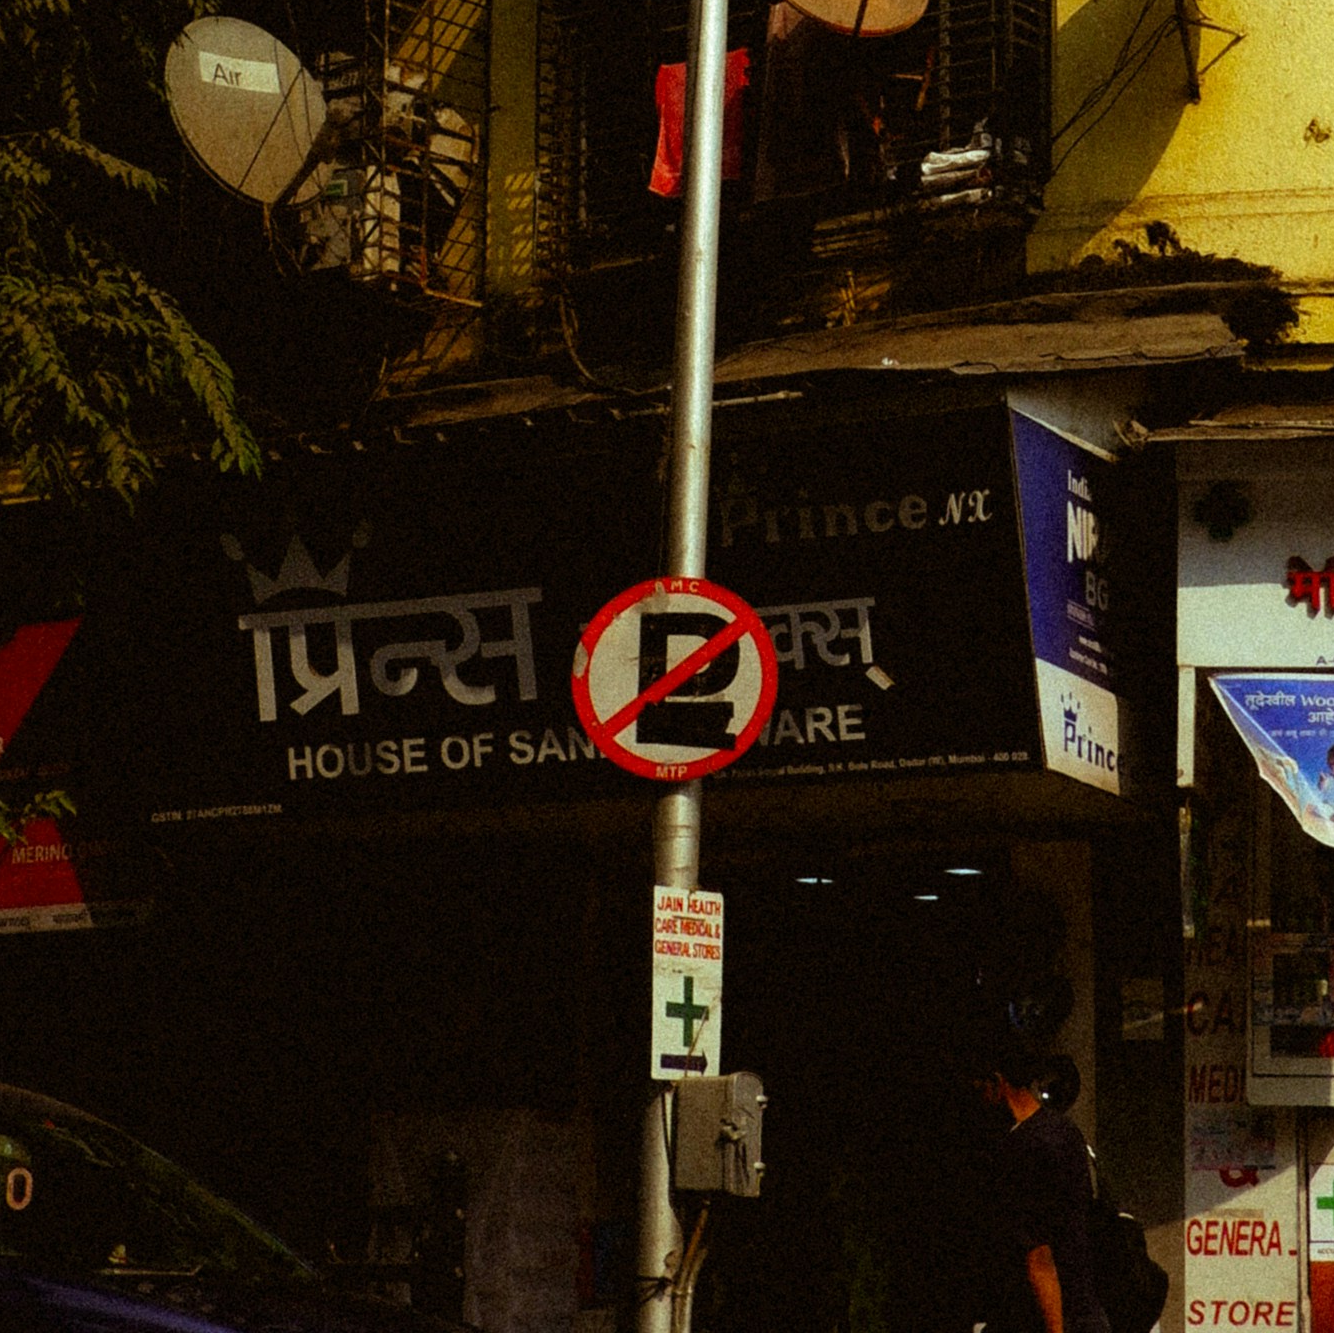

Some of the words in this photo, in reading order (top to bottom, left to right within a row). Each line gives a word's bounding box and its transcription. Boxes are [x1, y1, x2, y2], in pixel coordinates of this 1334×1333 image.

[286, 738, 429, 783] HOUSE
[439, 734, 495, 771] OF
[656, 766, 687, 778] MTP
[657, 896, 684, 913] JAIN
[1188, 1301, 1295, 1327] STORE
